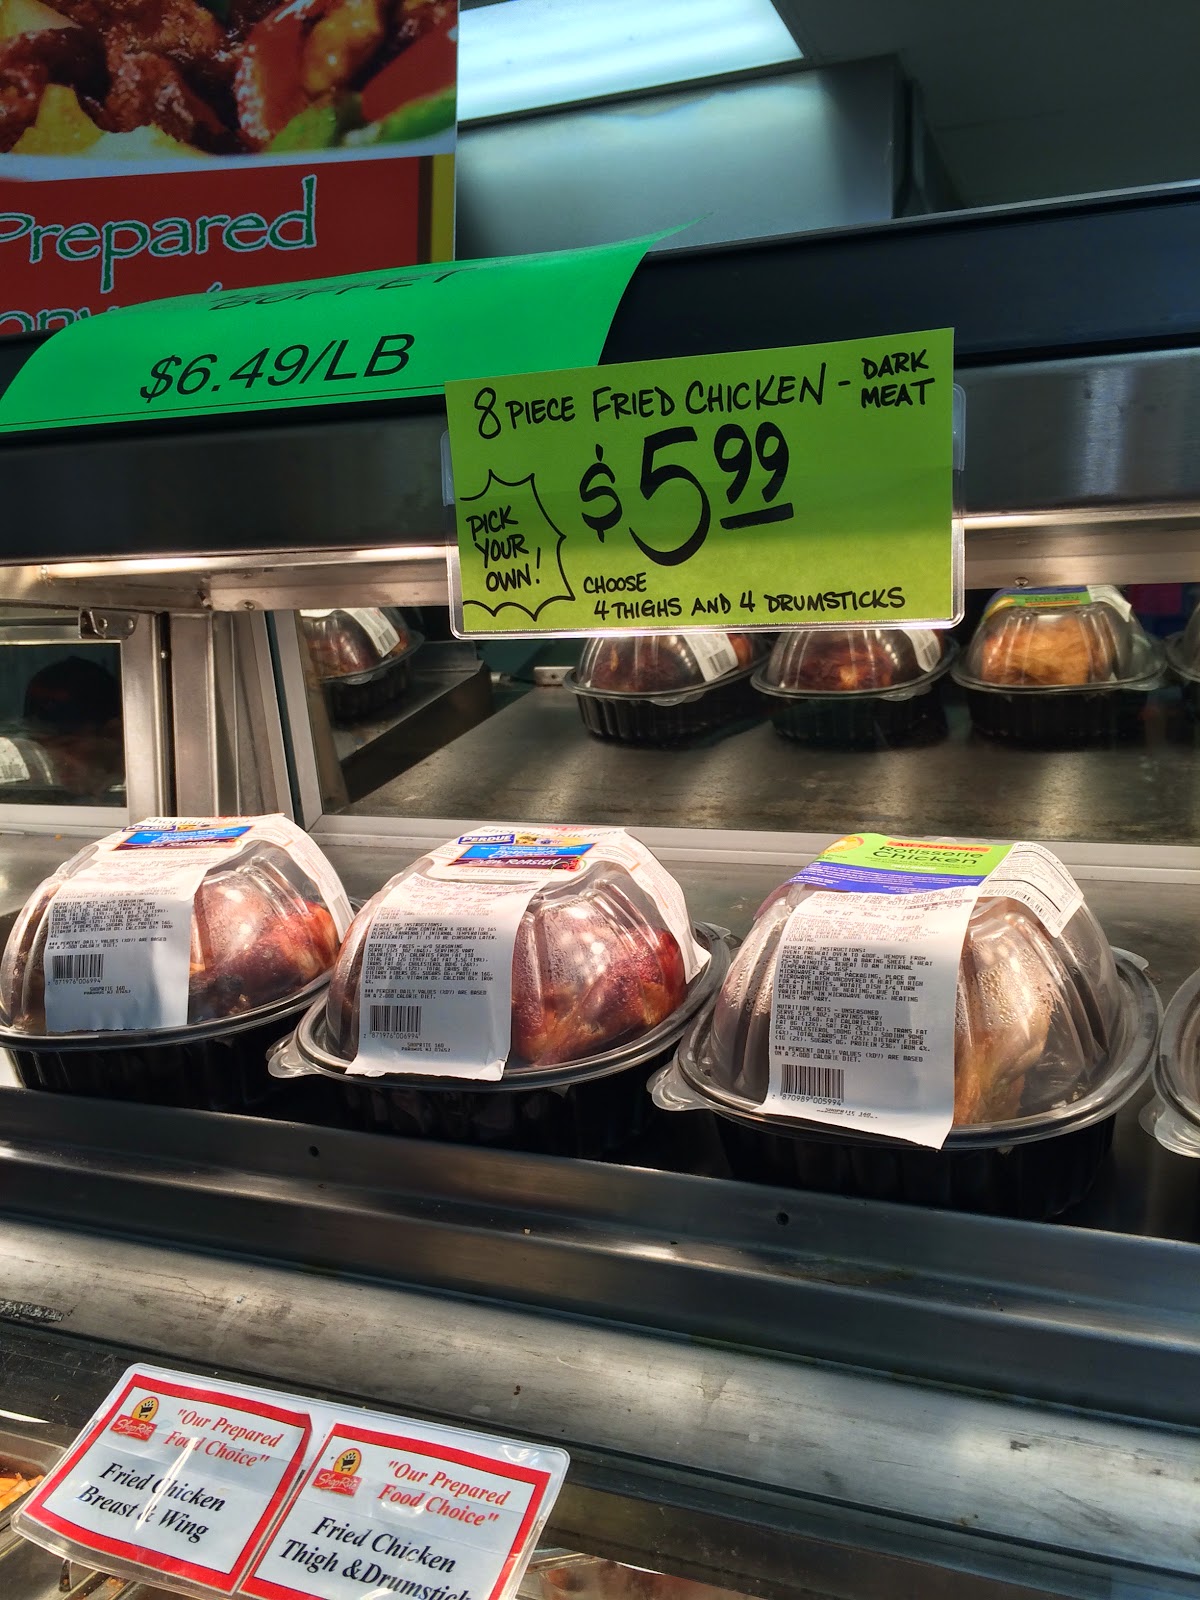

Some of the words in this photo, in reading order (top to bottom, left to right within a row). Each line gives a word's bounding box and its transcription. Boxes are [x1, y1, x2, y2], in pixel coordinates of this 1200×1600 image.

[139, 333, 415, 403] $6.49/LB
[474, 386, 502, 440] 8
[505, 395, 576, 426] PIECE
[592, 386, 675, 423] FRIED
[685, 361, 827, 415] CHICKEN
[861, 349, 930, 380] DARK
[860, 377, 936, 410] MEAT
[465, 505, 519, 542] PICK
[474, 537, 529, 569] YOUR
[484, 547, 542, 594] OWN!
[582, 572, 647, 595] CHOOSE
[690, 593, 731, 615] AND
[740, 591, 755, 611] 4
[766, 586, 906, 612] DRUMSTICKS
[461, 835, 512, 843] PERDUE
[879, 846, 983, 859] Rotisserie
[873, 851, 978, 865] Chicken
[782, 1094, 810, 1103] 870989
[115, 1418, 152, 1434] ShopRite
[177, 1408, 211, 1428] "Our
[211, 1417, 285, 1449] Prepared
[164, 1431, 207, 1451] Food
[205, 1440, 271, 1467] Choice"
[99, 1462, 155, 1491] Fried
[151, 1474, 227, 1512] Chicken
[314, 1472, 358, 1491] ShopRite
[388, 1460, 429, 1484] "Our
[429, 1470, 512, 1507] Prepared
[76, 1484, 138, 1519] Breast
[158, 1508, 210, 1544] Wing
[377, 1484, 426, 1508] Food
[424, 1495, 500, 1527] Choice"
[279, 1539, 339, 1574] Thigh
[311, 1516, 373, 1548] Fried
[371, 1532, 457, 1573] Chicken
